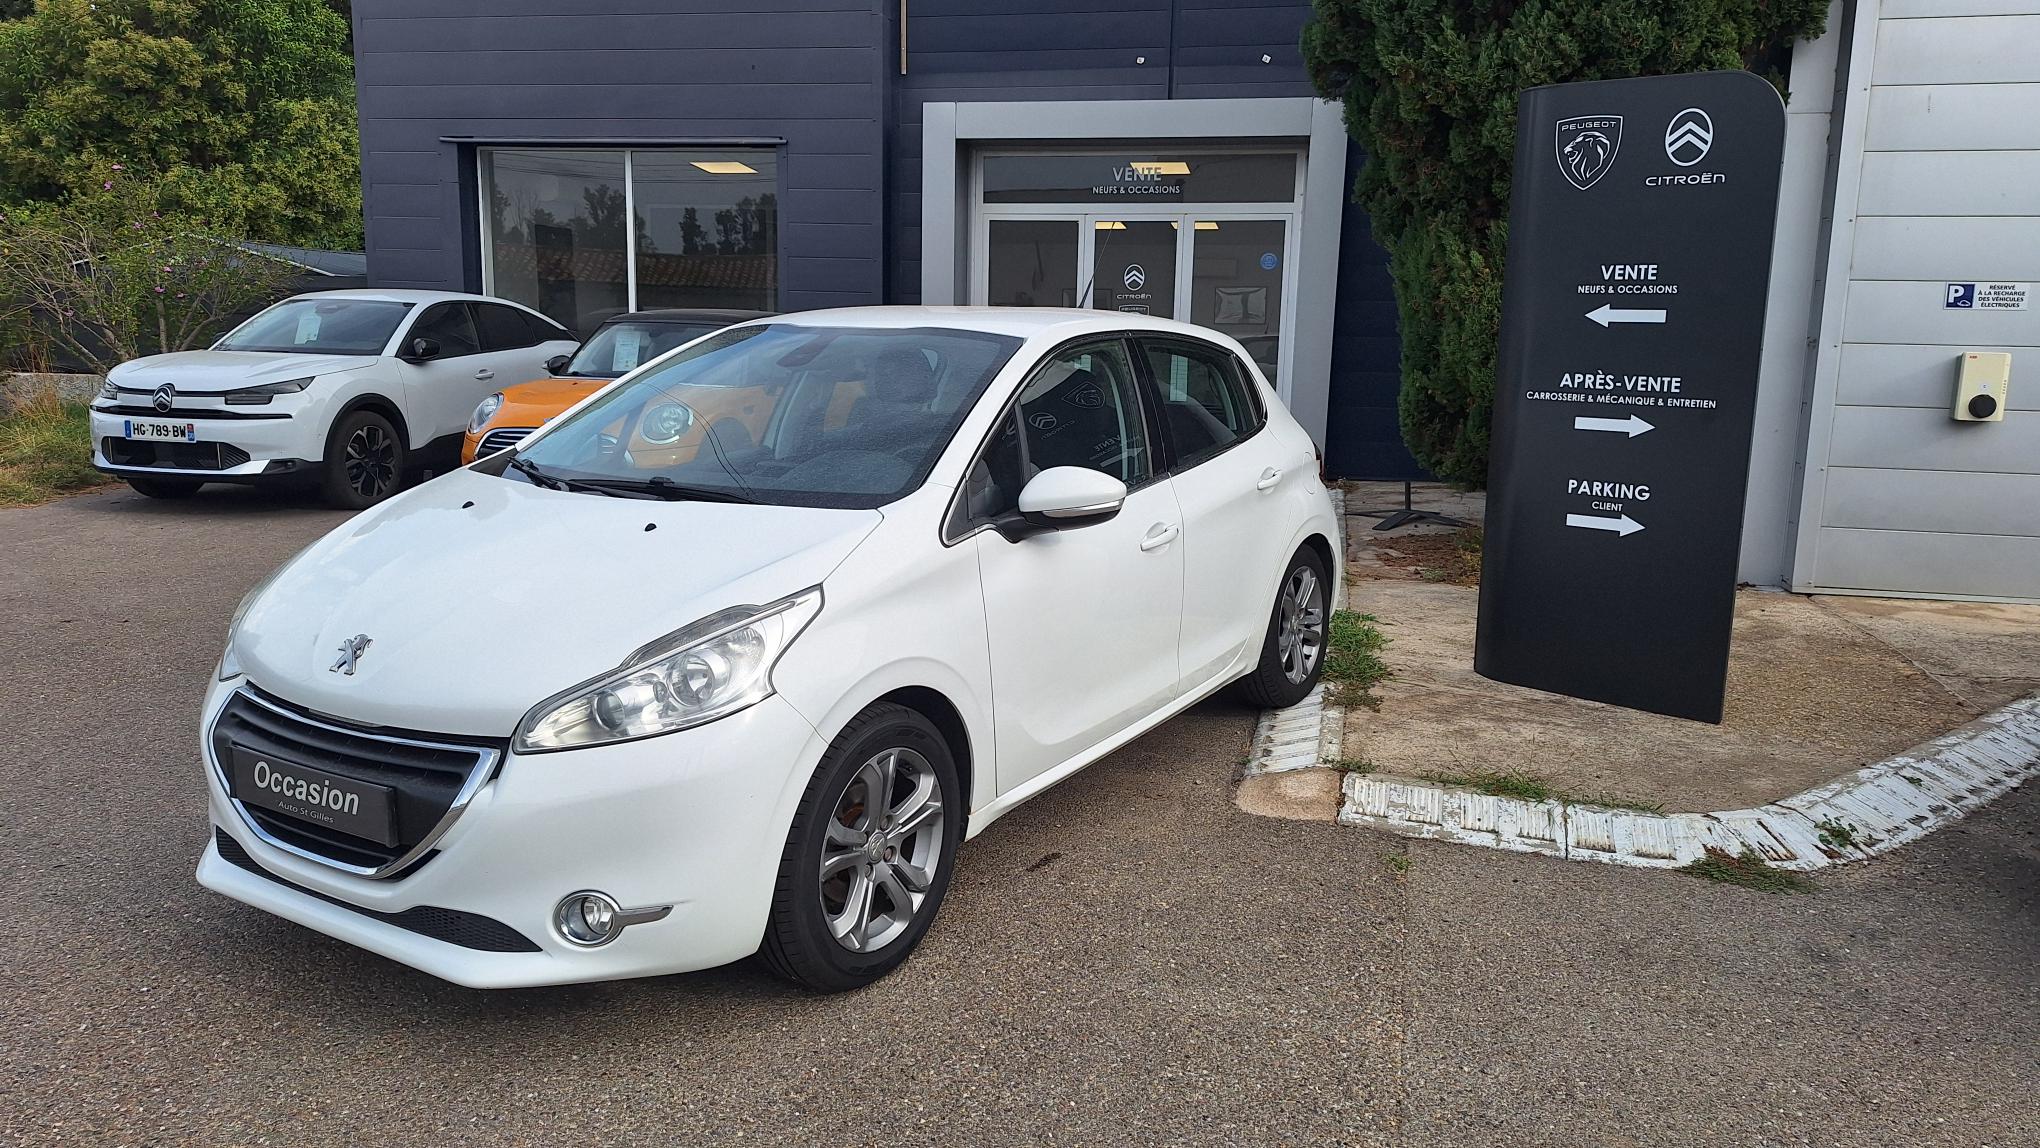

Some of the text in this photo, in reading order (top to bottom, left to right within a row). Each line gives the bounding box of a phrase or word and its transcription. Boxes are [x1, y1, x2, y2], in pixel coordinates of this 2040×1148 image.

[1561, 121, 1617, 132] PEUGEOT
[1112, 167, 1162, 181] VENTE
[1645, 173, 1726, 186] CITROËN
[1092, 185, 1181, 194] NEUFS & OCCASIONS
[1601, 264, 1658, 280] VENTE
[1577, 285, 1678, 294] NEUFS & OCCASIONS
[1559, 370, 1681, 393] APRÈS-VENTE
[1526, 391, 1717, 409] CARROSSERIE & MÉCANIQUE & ENTRETIEN
[1568, 479, 1651, 501] PARKING
[1592, 501, 1623, 512] CLIENT
[254, 761, 359, 815] Occasion
[278, 801, 334, 823] Auto St Gilles
